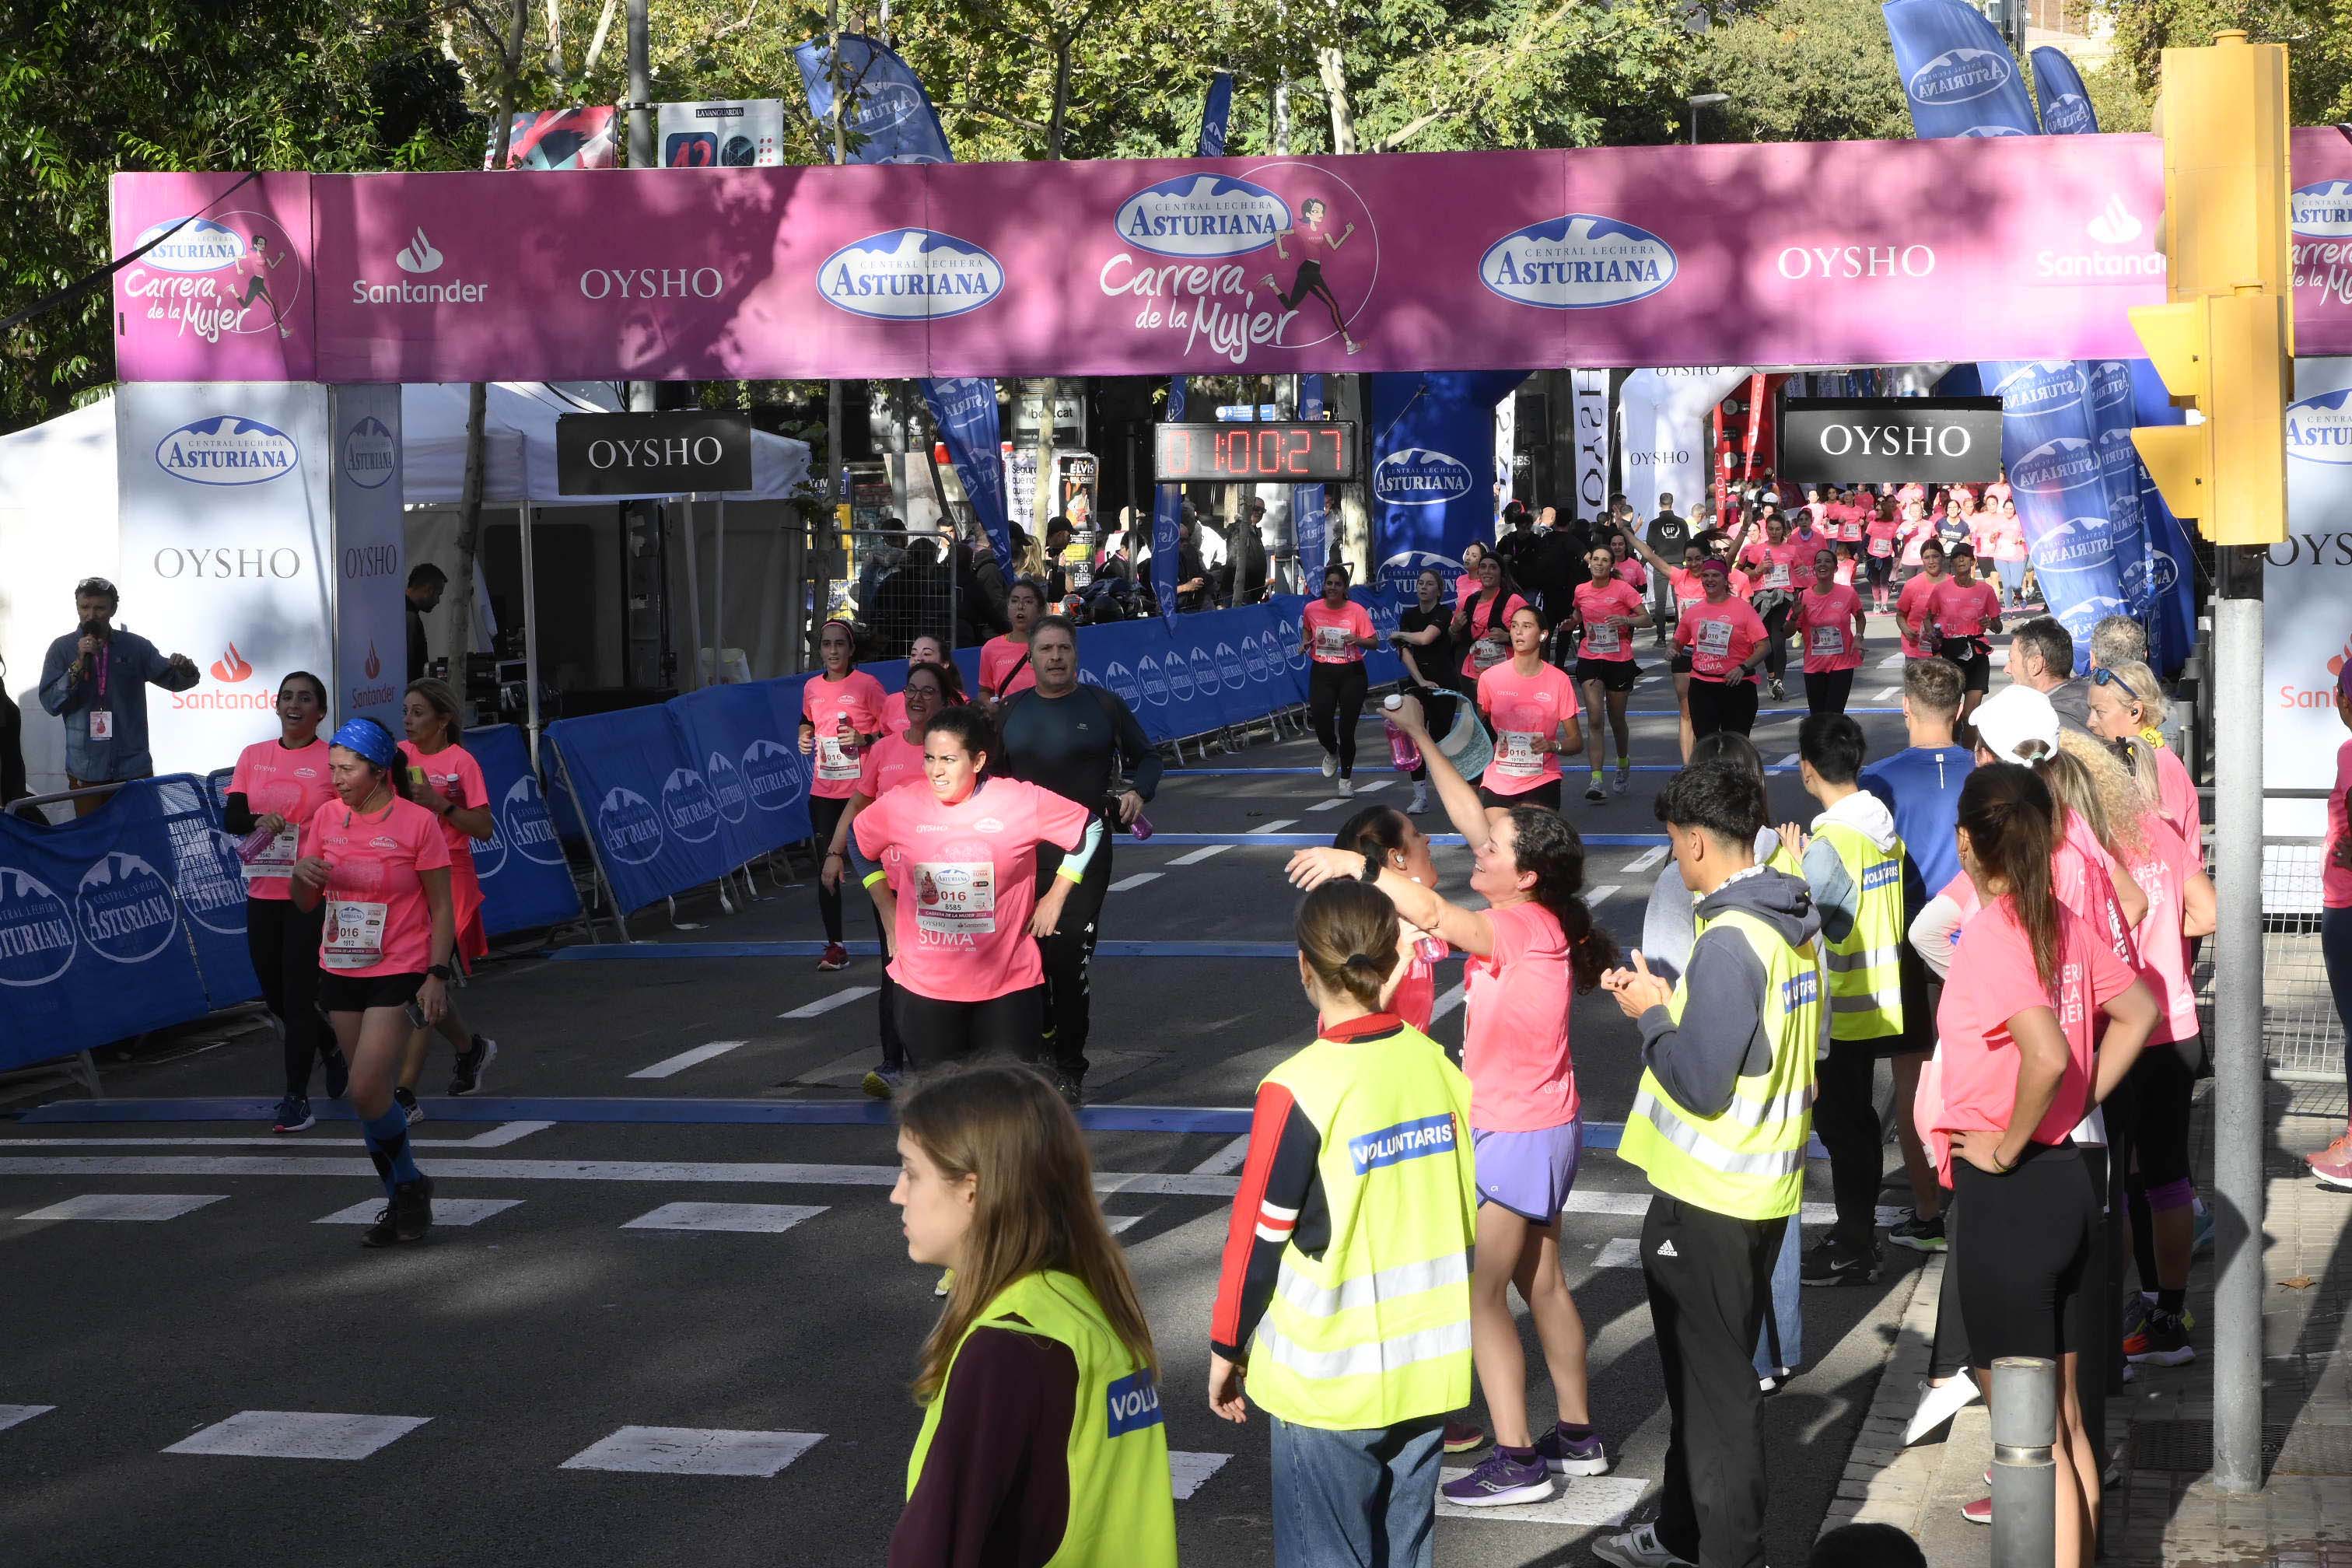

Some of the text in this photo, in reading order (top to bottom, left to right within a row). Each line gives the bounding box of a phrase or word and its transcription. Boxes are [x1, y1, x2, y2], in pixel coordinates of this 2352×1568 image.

[1129, 205, 1278, 236] ASTURIANA
[1155, 201, 1273, 212] CENTRAL LECHERA
[859, 259, 984, 269] CENTRAL LECHERA
[1524, 245, 1655, 257] CENTRAL LECHERA
[1778, 245, 1936, 281] OYSHO
[832, 262, 990, 296] ASTURIANA
[1100, 254, 1244, 296] Carrera
[1493, 251, 1661, 286] ASTURIANA
[2309, 267, 2323, 287] la
[124, 269, 215, 297] Carrera
[352, 279, 488, 304] Santander
[579, 269, 724, 300] OYSHO
[147, 296, 251, 343] de la Mujer
[1136, 292, 1300, 365] de la Mujer
[188, 439, 284, 448] CENTRAL LECHERA
[589, 436, 723, 468] OYSHO
[1820, 424, 1972, 457] OYSHO
[166, 442, 289, 468] ASTURIANA
[1069, 463, 1094, 474] ELVIS
[1631, 450, 1689, 467] OYSHO
[1377, 471, 1465, 492] ASTURIANA
[154, 548, 300, 579] OYSHO
[345, 544, 397, 579] OYSHO
[1079, 564, 1088, 573] 30
[352, 684, 396, 711] Santander
[941, 891, 966, 901] 016
[89, 894, 173, 942] ASTURIANA
[340, 927, 359, 938] 016
[919, 928, 975, 946] SUMA
[1355, 1123, 1452, 1164] VOLUNTARIS
[1111, 1385, 1158, 1421] VOLU
